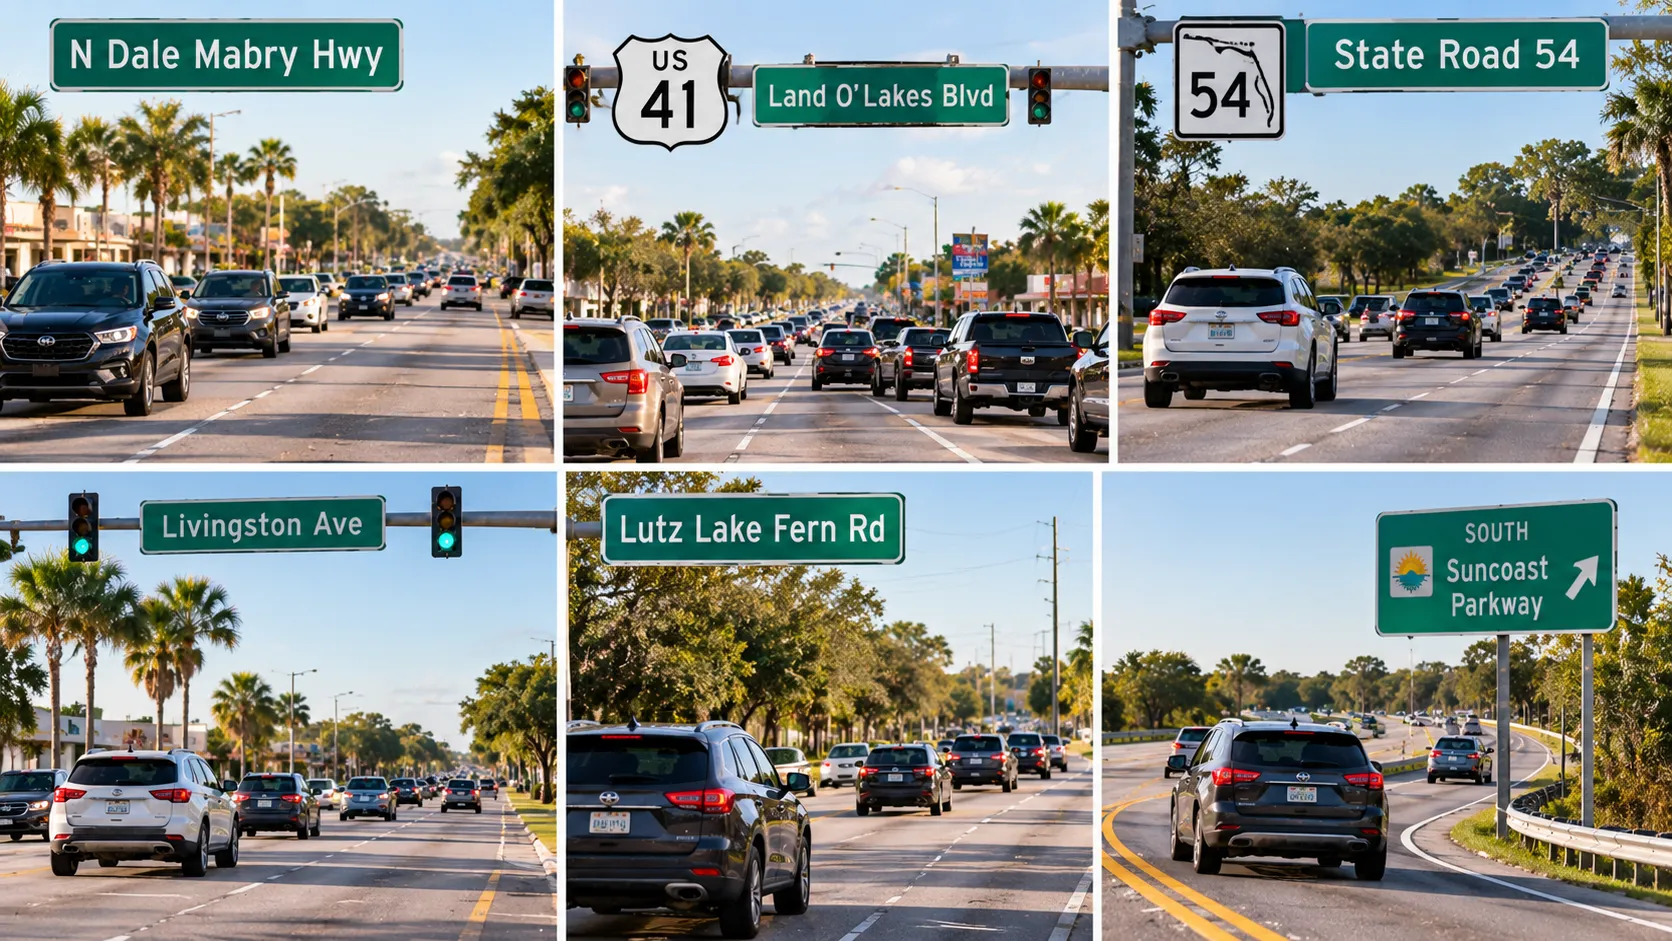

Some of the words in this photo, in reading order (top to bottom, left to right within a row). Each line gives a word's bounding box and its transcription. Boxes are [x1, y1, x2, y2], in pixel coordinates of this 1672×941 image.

[70, 38, 92, 69] N
[108, 38, 180, 70] Dale
[195, 38, 298, 77] Mabry
[313, 38, 384, 77] Hwy
[652, 49, 688, 72] US
[1334, 38, 1425, 70] State
[1440, 38, 1520, 70] Road
[1535, 38, 1580, 70] 54
[640, 79, 695, 129] 41
[769, 83, 826, 108] Land
[943, 83, 993, 107] Blvd
[1190, 71, 1251, 119] 54
[163, 511, 302, 543] Livingston
[313, 511, 363, 537] Ave
[620, 514, 683, 544] Lutz
[695, 513, 762, 543] Lake
[774, 513, 836, 543] Fern
[849, 513, 886, 543] Rd
[1465, 521, 1528, 544] SOUTH
[1447, 555, 1549, 583] Suncoast
[1452, 591, 1543, 621] Parkway
